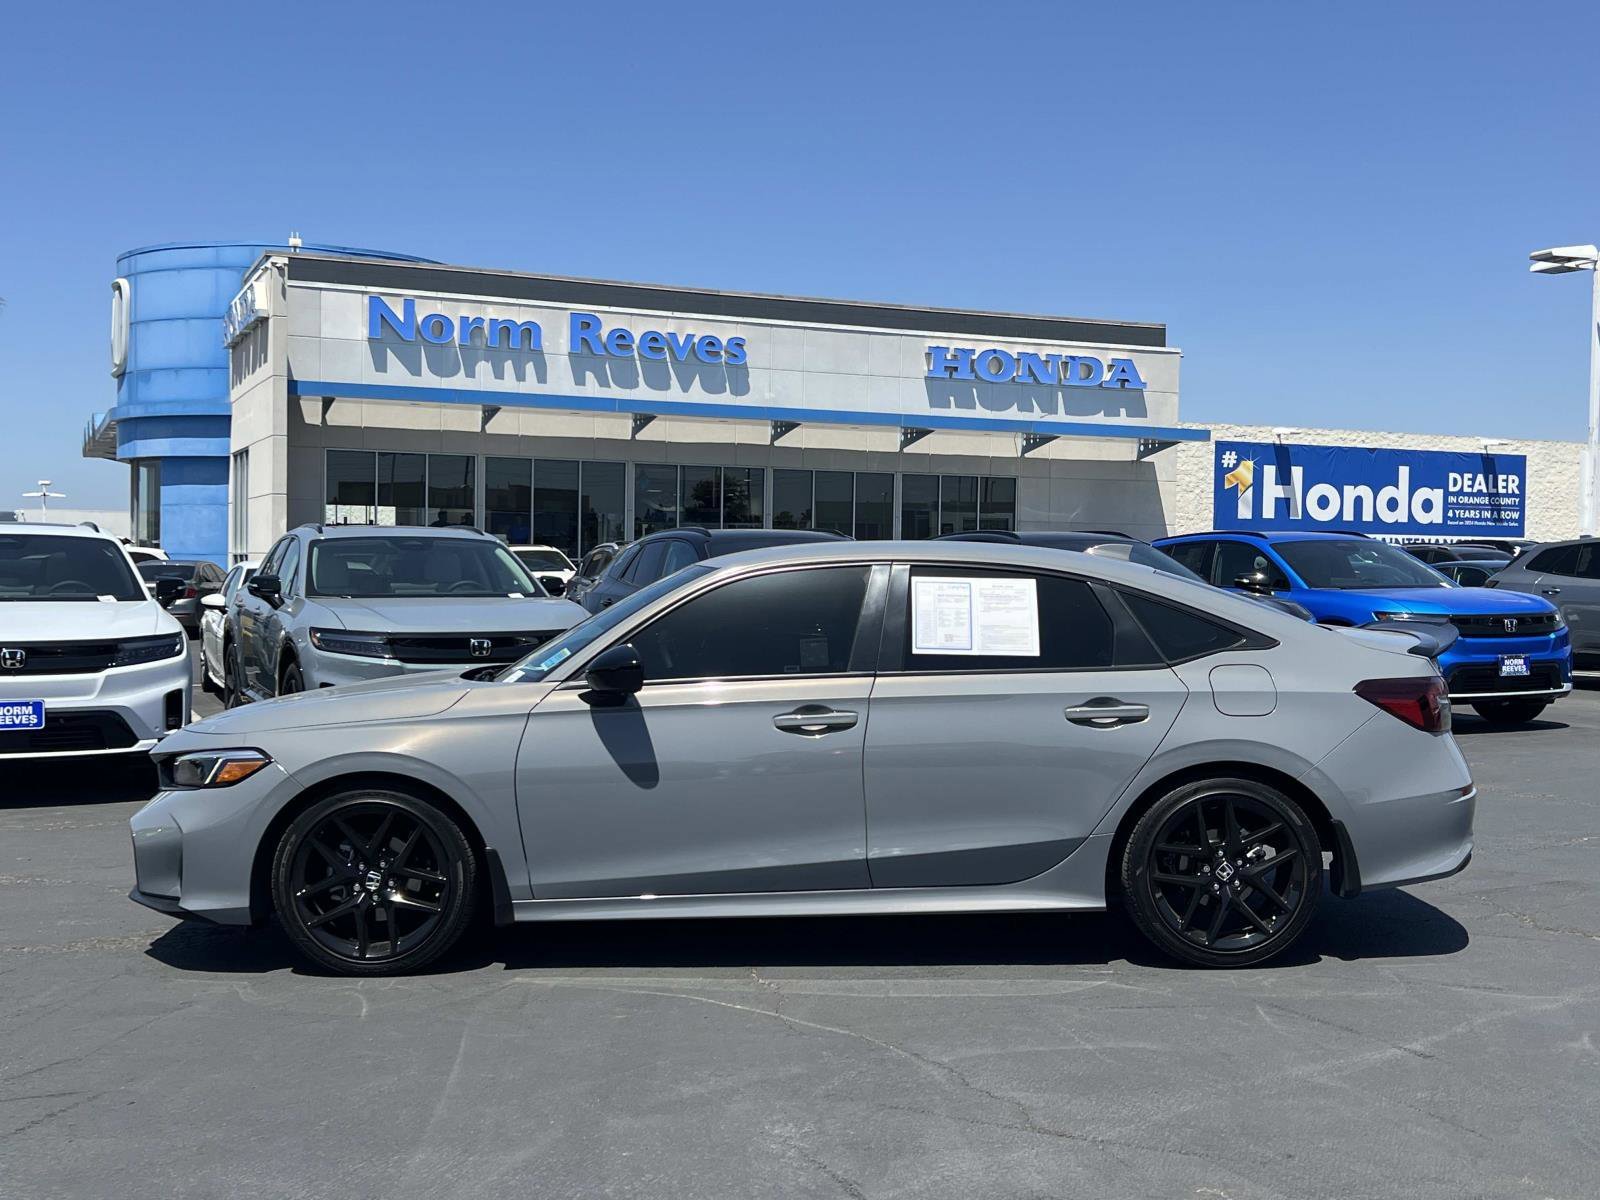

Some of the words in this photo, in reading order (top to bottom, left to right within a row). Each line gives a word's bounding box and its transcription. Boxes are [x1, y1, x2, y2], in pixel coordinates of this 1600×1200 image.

[367, 295, 542, 351] Norm
[568, 311, 748, 365] Reeves
[927, 346, 1147, 389] HONDA
[1448, 472, 1520, 494] DEALER
[1262, 465, 1443, 525] Honda
[1458, 496, 1489, 504] ORANGE
[1490, 497, 1520, 505] COUNTY
[1447, 510, 1453, 518] 4
[1455, 510, 1480, 518] YEARS
[1481, 510, 1491, 518] IN
[1500, 511, 1520, 519] ROW
[0, 715, 38, 724] EEVES
